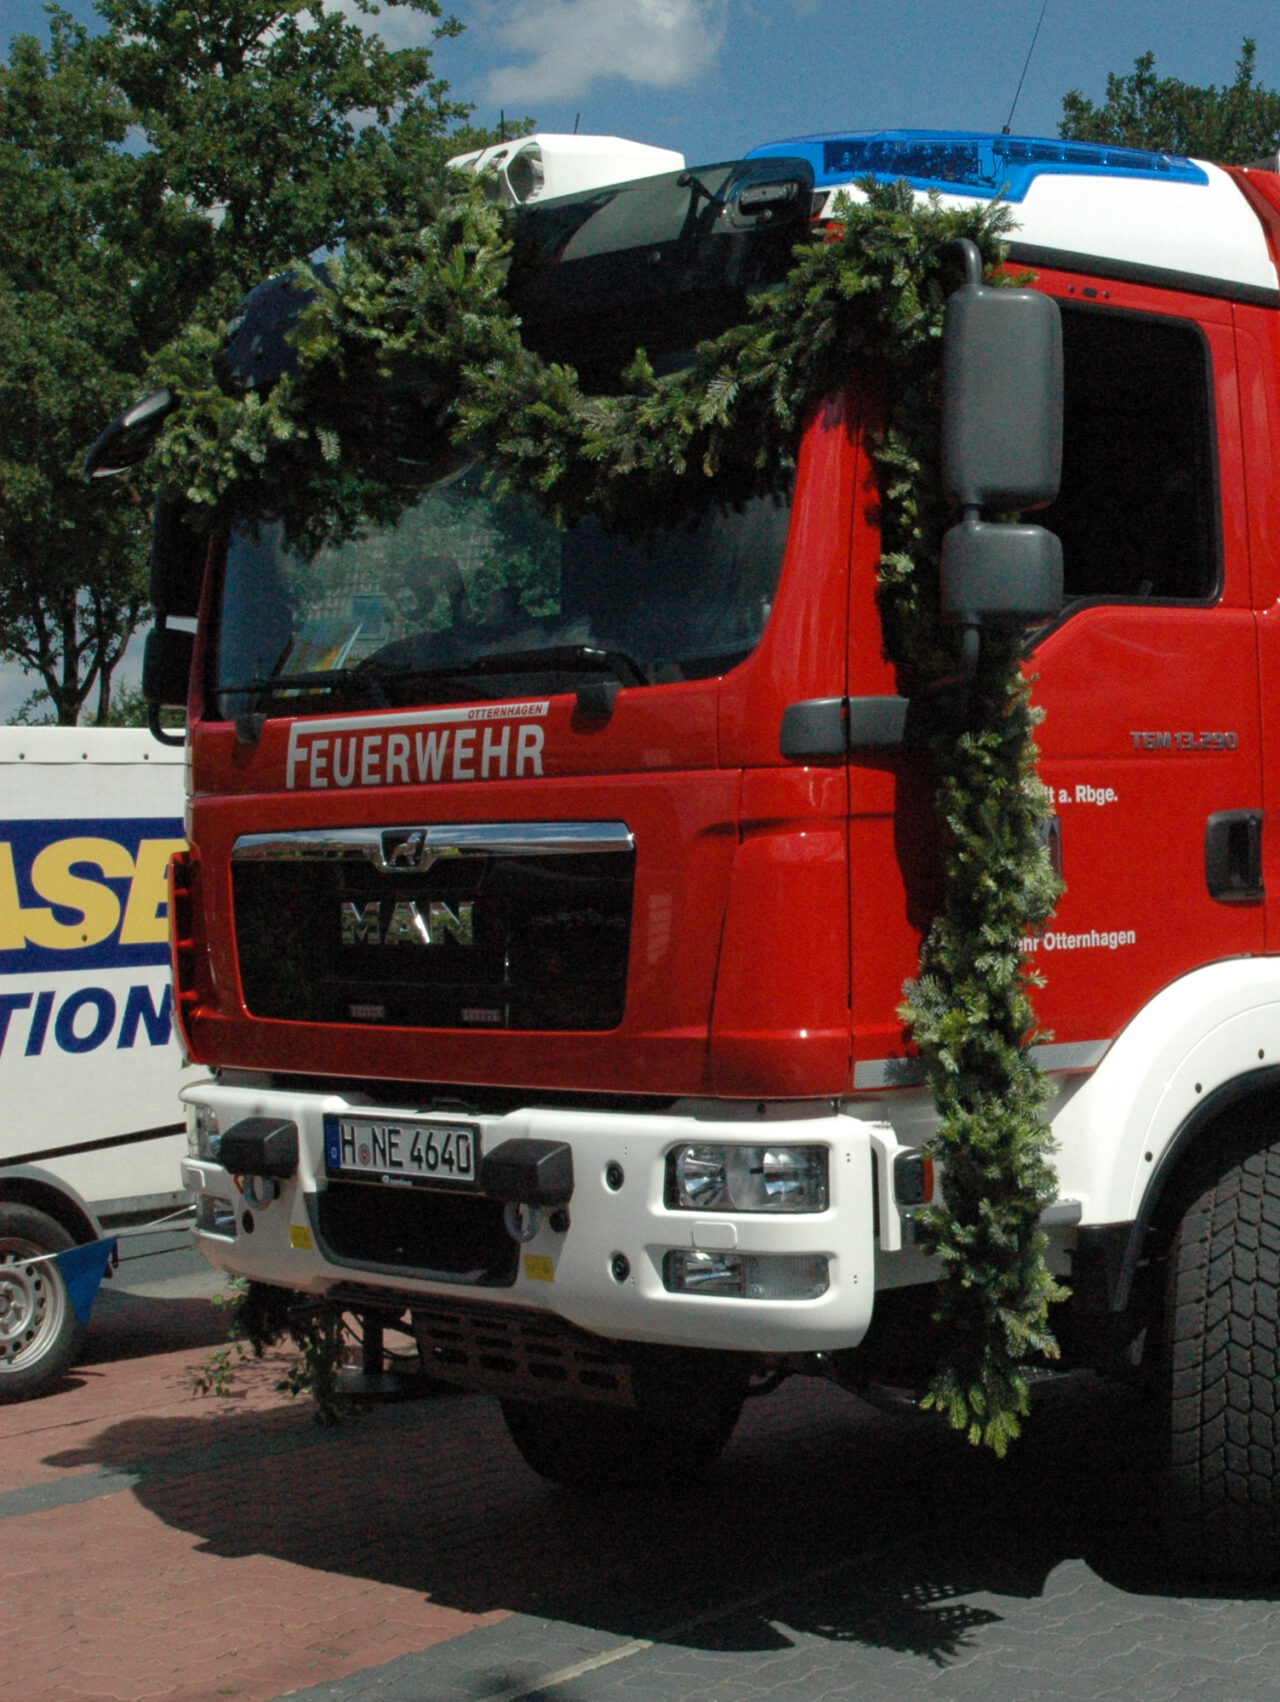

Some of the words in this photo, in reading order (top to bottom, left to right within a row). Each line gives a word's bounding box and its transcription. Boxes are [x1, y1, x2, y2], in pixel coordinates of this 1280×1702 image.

[468, 704, 543, 720] OTTERNHAGEN
[1130, 731, 1171, 750] TGM
[1174, 731, 1239, 750] 13.290
[285, 722, 545, 790] FEUERWEHR
[1075, 784, 1118, 806] Rbge.
[341, 901, 473, 944] MAN
[1043, 930, 1136, 949] Otternhagen
[372, 1127, 403, 1167] NE
[410, 1129, 472, 1173] 4640
